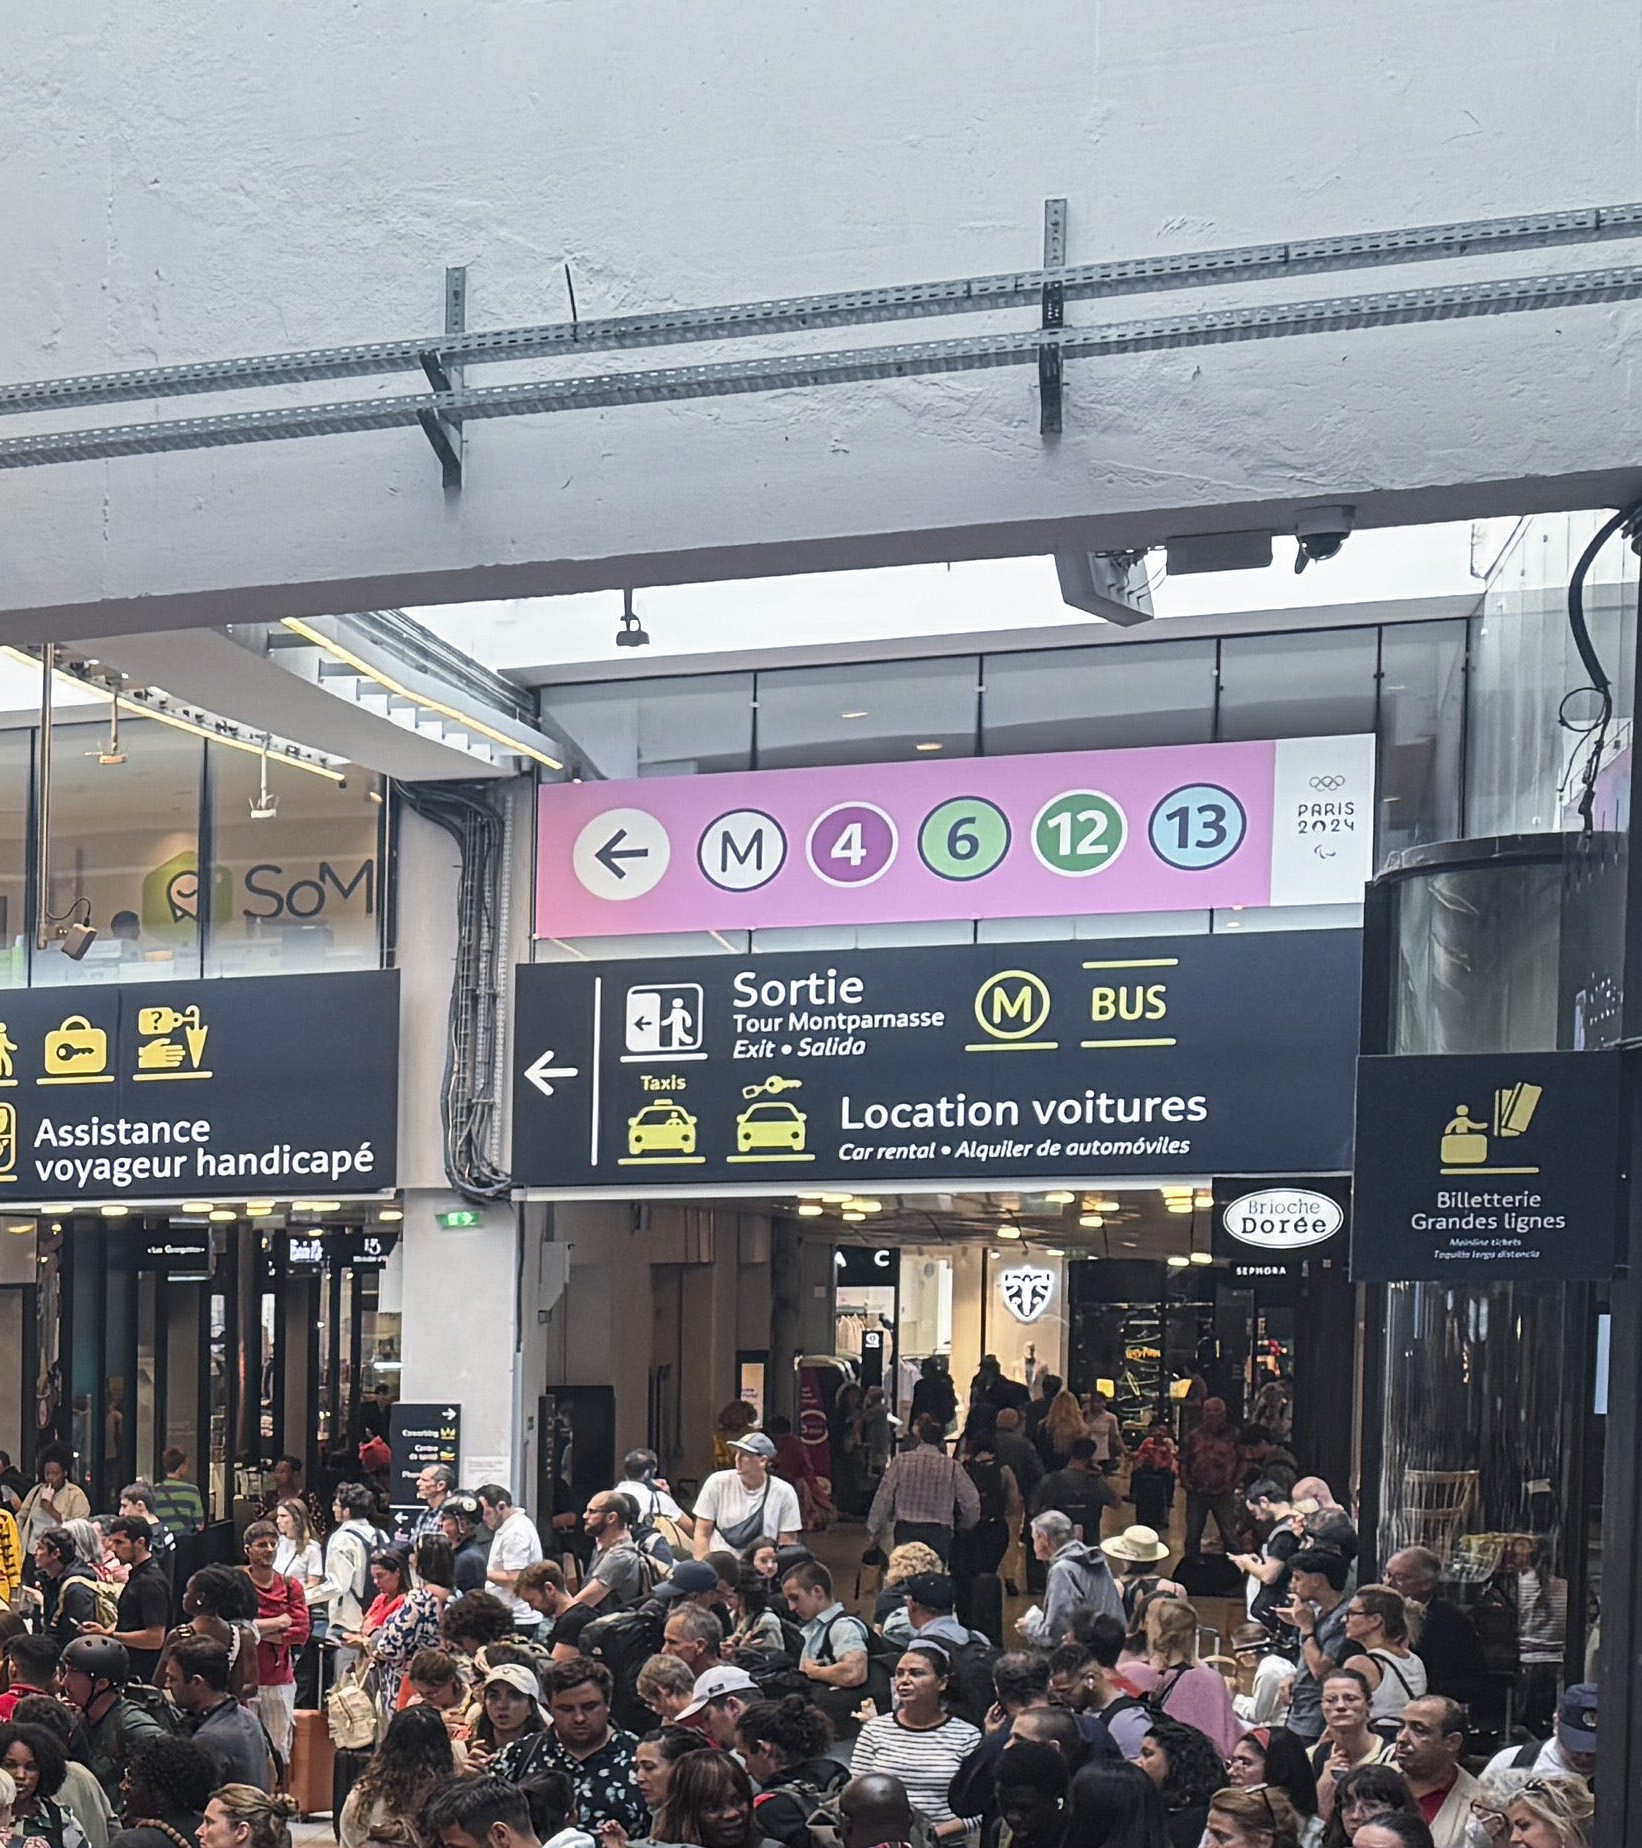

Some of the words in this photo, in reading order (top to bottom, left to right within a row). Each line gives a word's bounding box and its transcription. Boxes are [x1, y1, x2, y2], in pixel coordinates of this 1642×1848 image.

[1298, 802, 1355, 818] PARIS
[720, 831, 763, 872] M
[831, 824, 867, 866] 4
[946, 815, 978, 860] 6
[1047, 812, 1112, 857] 12
[1166, 805, 1227, 850] 13
[1298, 819, 1355, 834] 2024
[734, 971, 864, 1006] Sortie
[991, 986, 1034, 1024] M
[1093, 984, 1168, 1023] BUS
[734, 1012, 786, 1031] Tour
[788, 1008, 945, 1033] Montparnasse
[733, 1037, 774, 1059] Exit
[797, 1036, 866, 1057] Salida
[641, 1075, 687, 1093] Taxis
[841, 1094, 1020, 1133] Location
[1033, 1090, 1209, 1127] voitures
[34, 1117, 210, 1147] Assistance
[839, 1143, 874, 1161] Car
[877, 1140, 935, 1160] rental
[955, 1136, 1033, 1161] Alquiler
[1036, 1137, 1060, 1157] de
[1064, 1134, 1191, 1157] automóviles
[35, 1155, 187, 1188] voyageur
[195, 1141, 373, 1182] handicapé
[1249, 1199, 1321, 1214] Brioche
[1437, 1191, 1541, 1208] Billetterie
[1241, 1217, 1326, 1233] Dorée
[1411, 1213, 1497, 1229] Grandes
[1504, 1213, 1565, 1233] lignes
[1236, 1266, 1287, 1275] SEPHORA
